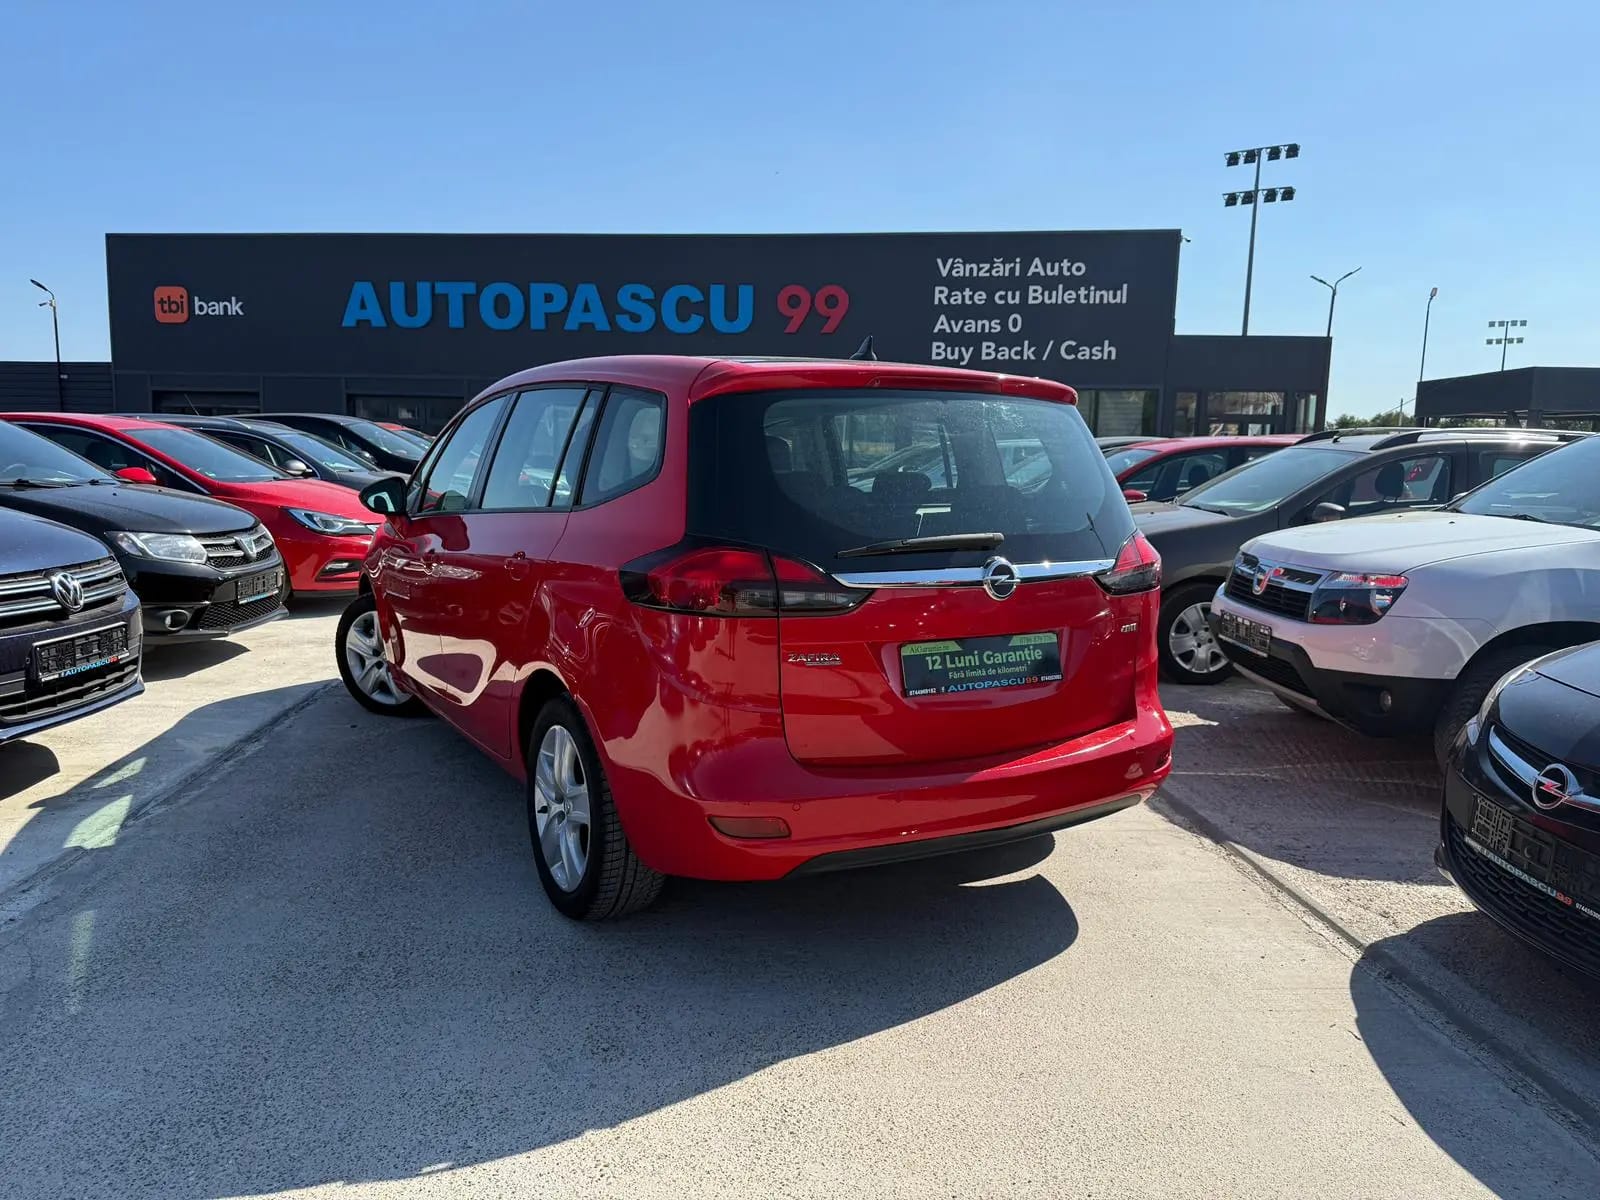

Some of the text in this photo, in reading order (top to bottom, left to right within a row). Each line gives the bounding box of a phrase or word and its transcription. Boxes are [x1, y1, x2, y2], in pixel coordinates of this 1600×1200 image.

[937, 257, 1086, 277] Vânzări Auto
[934, 284, 1128, 305] Rate cu Buletinul
[158, 294, 244, 316] tbi bank
[342, 281, 849, 334] AUTOPASCU 99
[933, 314, 1022, 333] Avans 0
[932, 340, 1117, 365] Buy Back / Cash
[788, 653, 840, 662] ZAFIRA
[926, 656, 943, 670] 12
[946, 651, 980, 668] Luni
[988, 667, 996, 675] de
[997, 664, 1028, 674] kilometri
